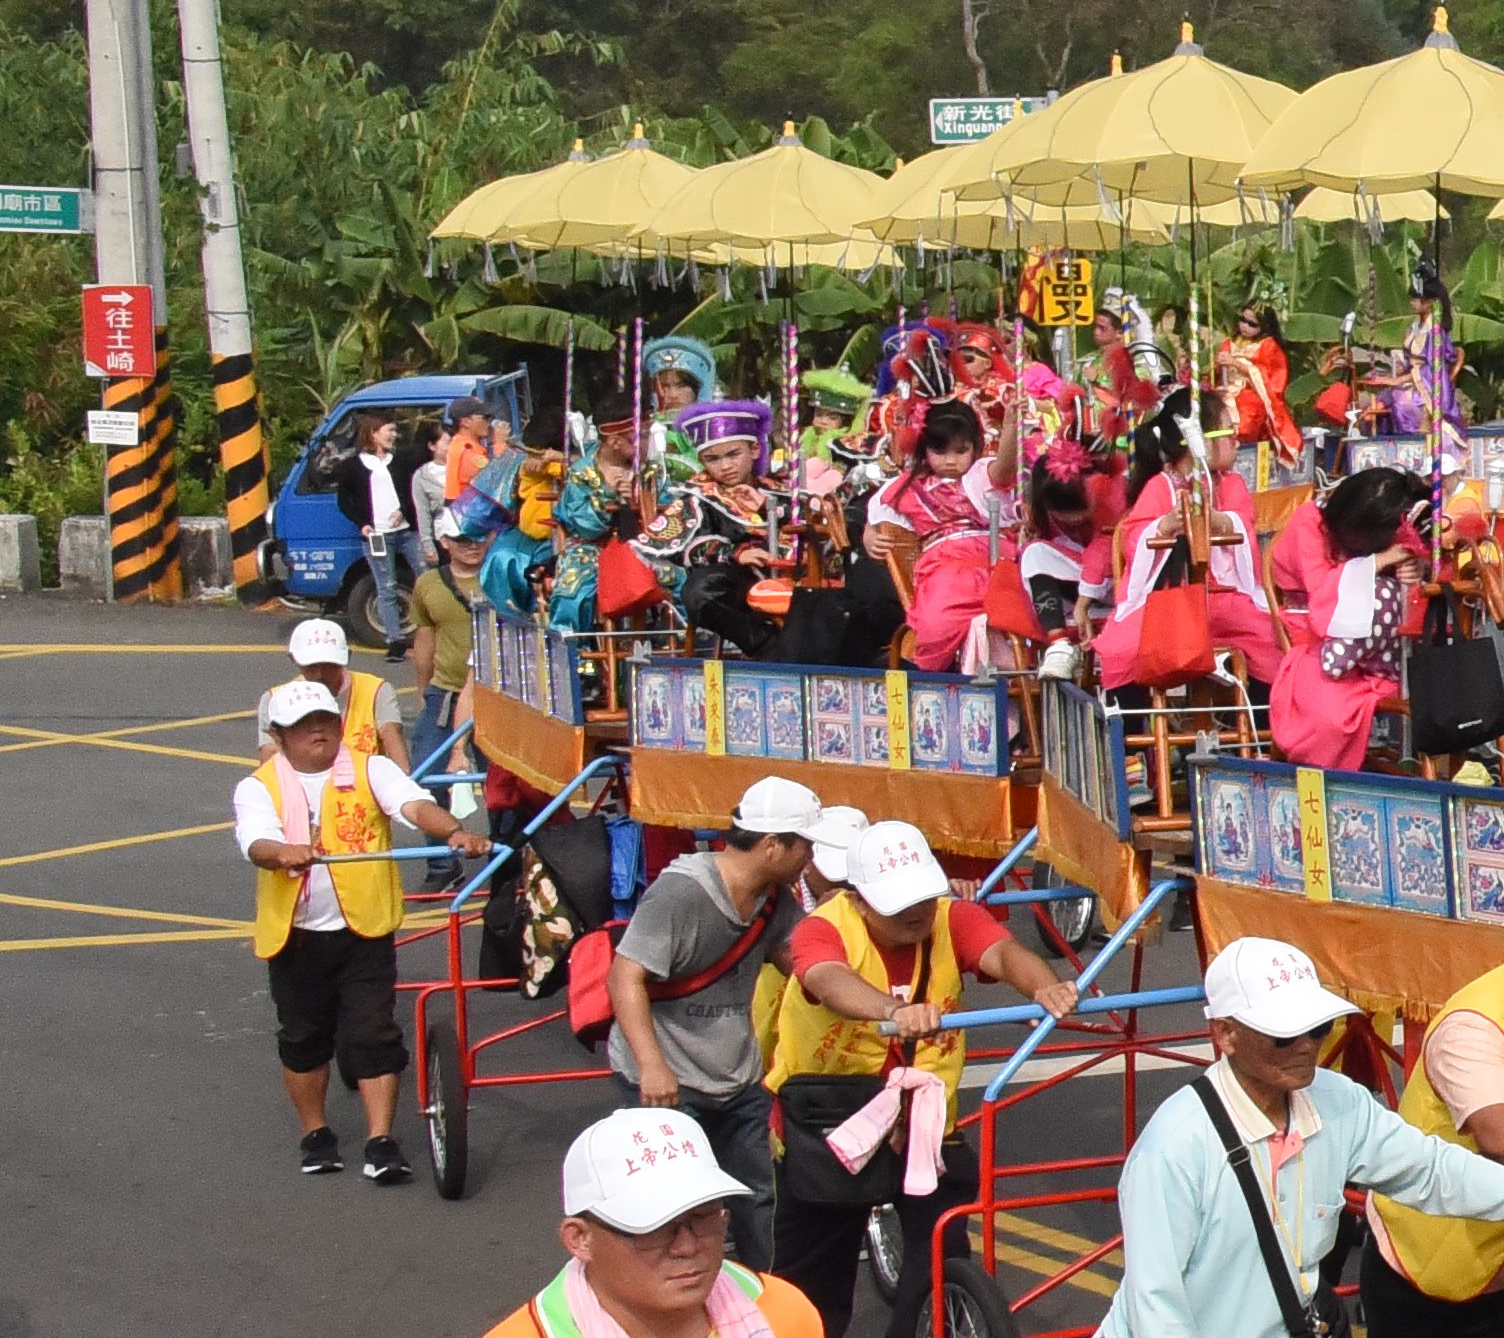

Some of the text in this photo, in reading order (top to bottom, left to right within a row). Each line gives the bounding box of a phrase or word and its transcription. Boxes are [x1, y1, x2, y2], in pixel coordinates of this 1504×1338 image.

[0, 194, 62, 212] 廟市區
[1039, 263, 1090, 323] 慢
[105, 307, 135, 372] 往土崎
[892, 688, 905, 760] 七仙女
[879, 851, 920, 873] 上帝公壇
[1304, 791, 1326, 886] 七仙女
[626, 1140, 699, 1176] 上帝公壇
[633, 1123, 674, 1145] 花園
